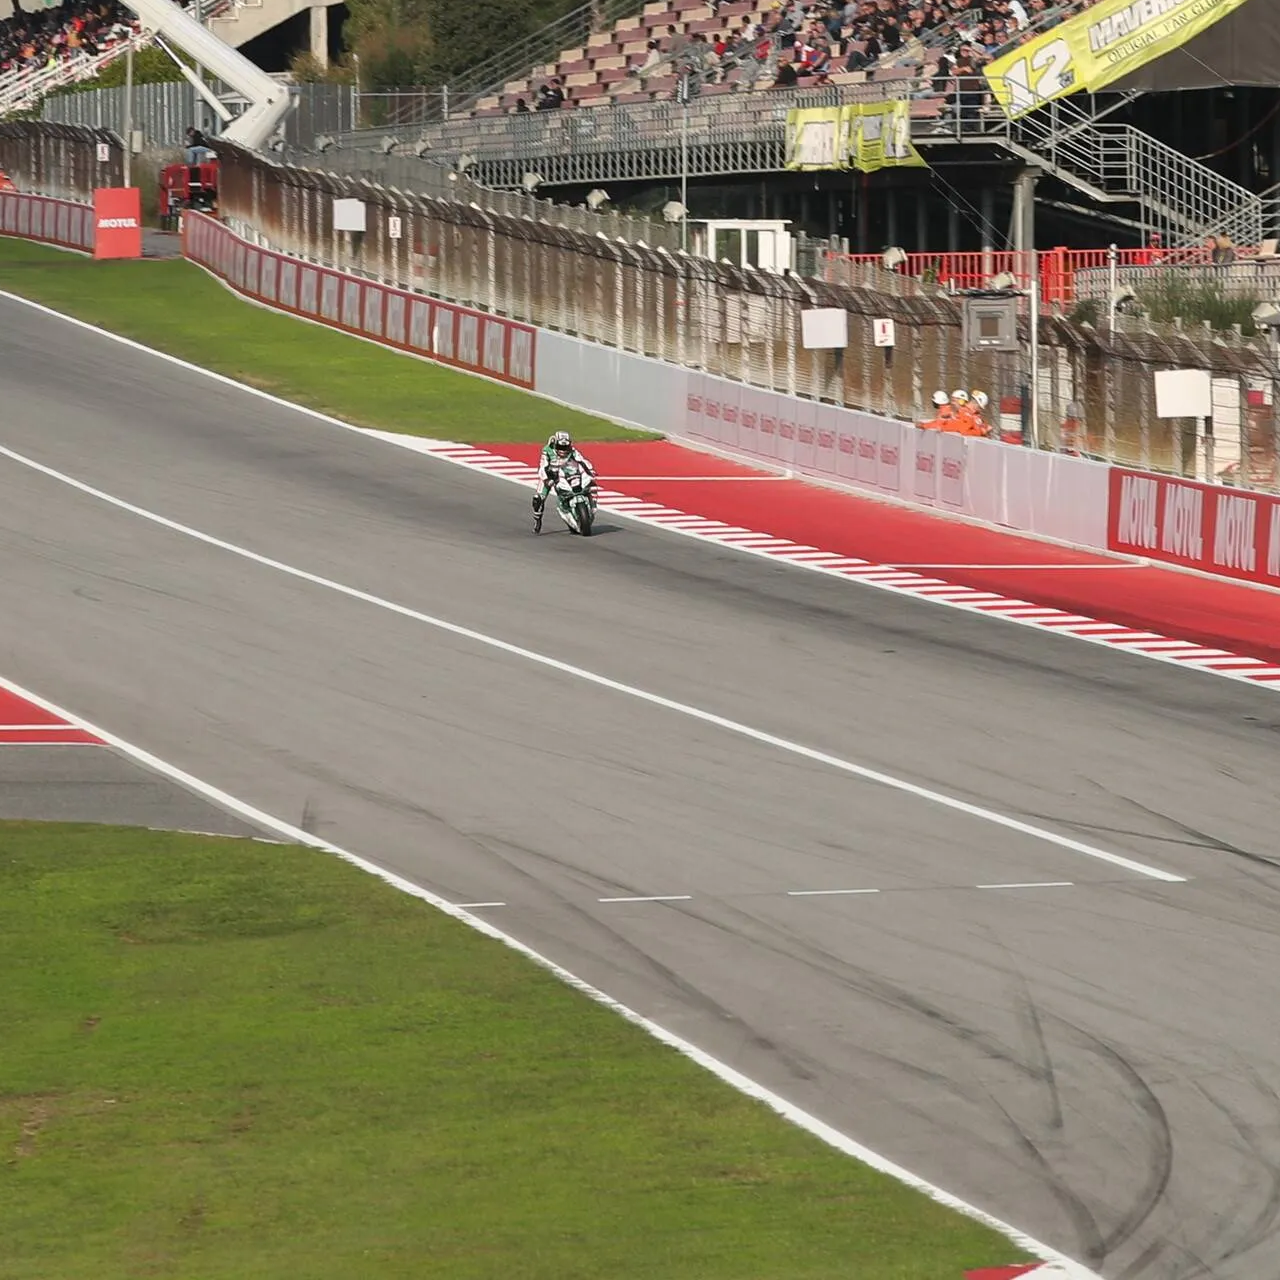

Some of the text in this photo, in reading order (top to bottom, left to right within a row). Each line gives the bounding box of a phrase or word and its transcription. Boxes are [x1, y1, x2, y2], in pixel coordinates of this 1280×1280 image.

[1003, 37, 1075, 117] 12
[1118, 476, 1158, 549] MOTUL
[1162, 483, 1204, 560] MOTUL
[1214, 494, 1257, 572] MOTUL
